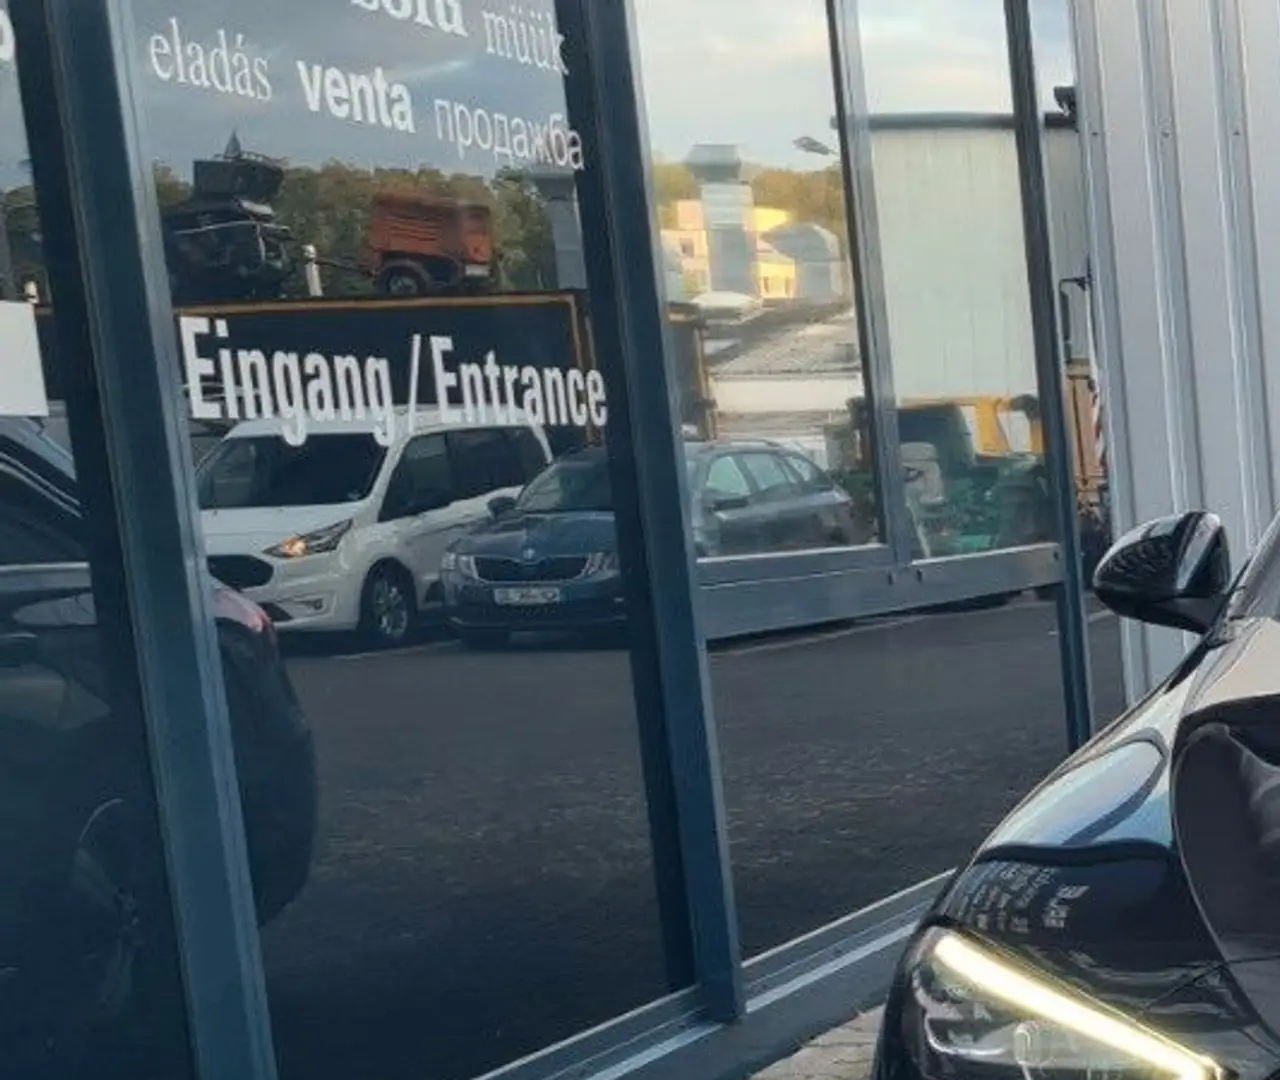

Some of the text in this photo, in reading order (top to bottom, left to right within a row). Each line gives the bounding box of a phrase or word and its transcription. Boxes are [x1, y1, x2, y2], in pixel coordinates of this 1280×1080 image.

[150, 16, 272, 100] eladás
[296, 60, 416, 133] venta
[434, 98, 584, 170] продажба
[179, 316, 396, 446] Eingang
[430, 334, 607, 427] Entrance
